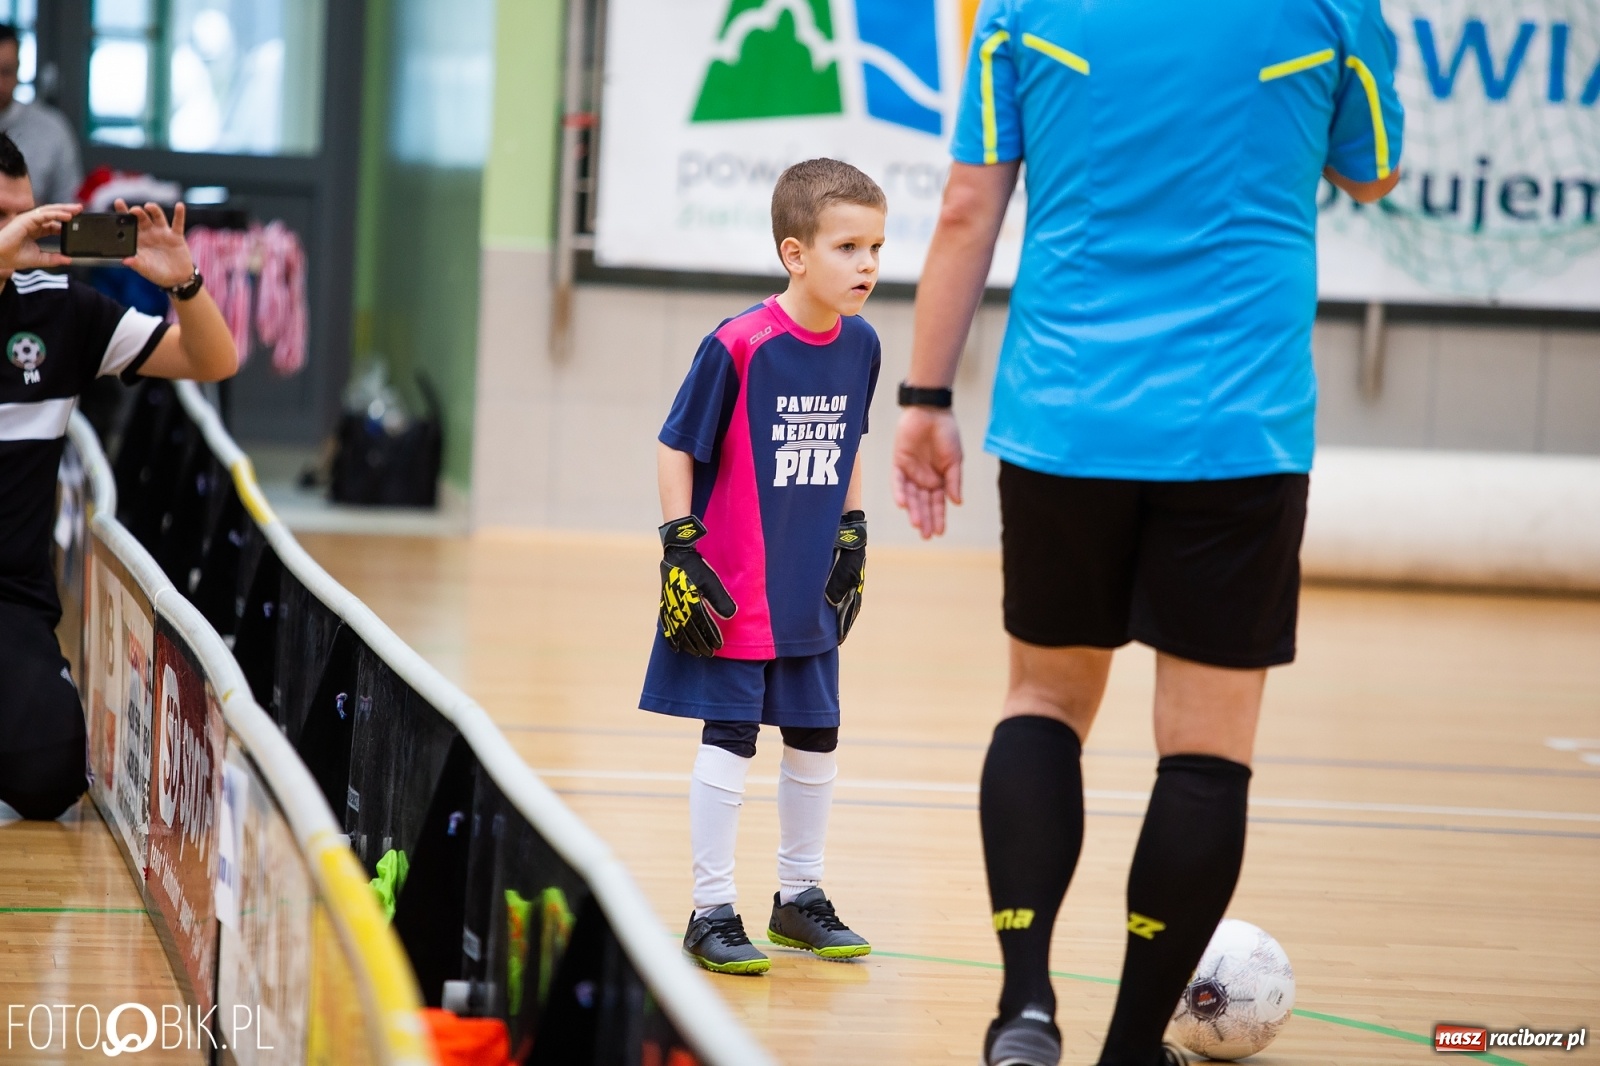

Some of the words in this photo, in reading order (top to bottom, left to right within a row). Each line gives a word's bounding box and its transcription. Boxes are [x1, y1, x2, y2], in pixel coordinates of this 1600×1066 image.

[23, 369, 41, 385] PM
[776, 395, 848, 412] PAWILON
[771, 422, 847, 441] MEBLOWY
[773, 449, 841, 487] PIK
